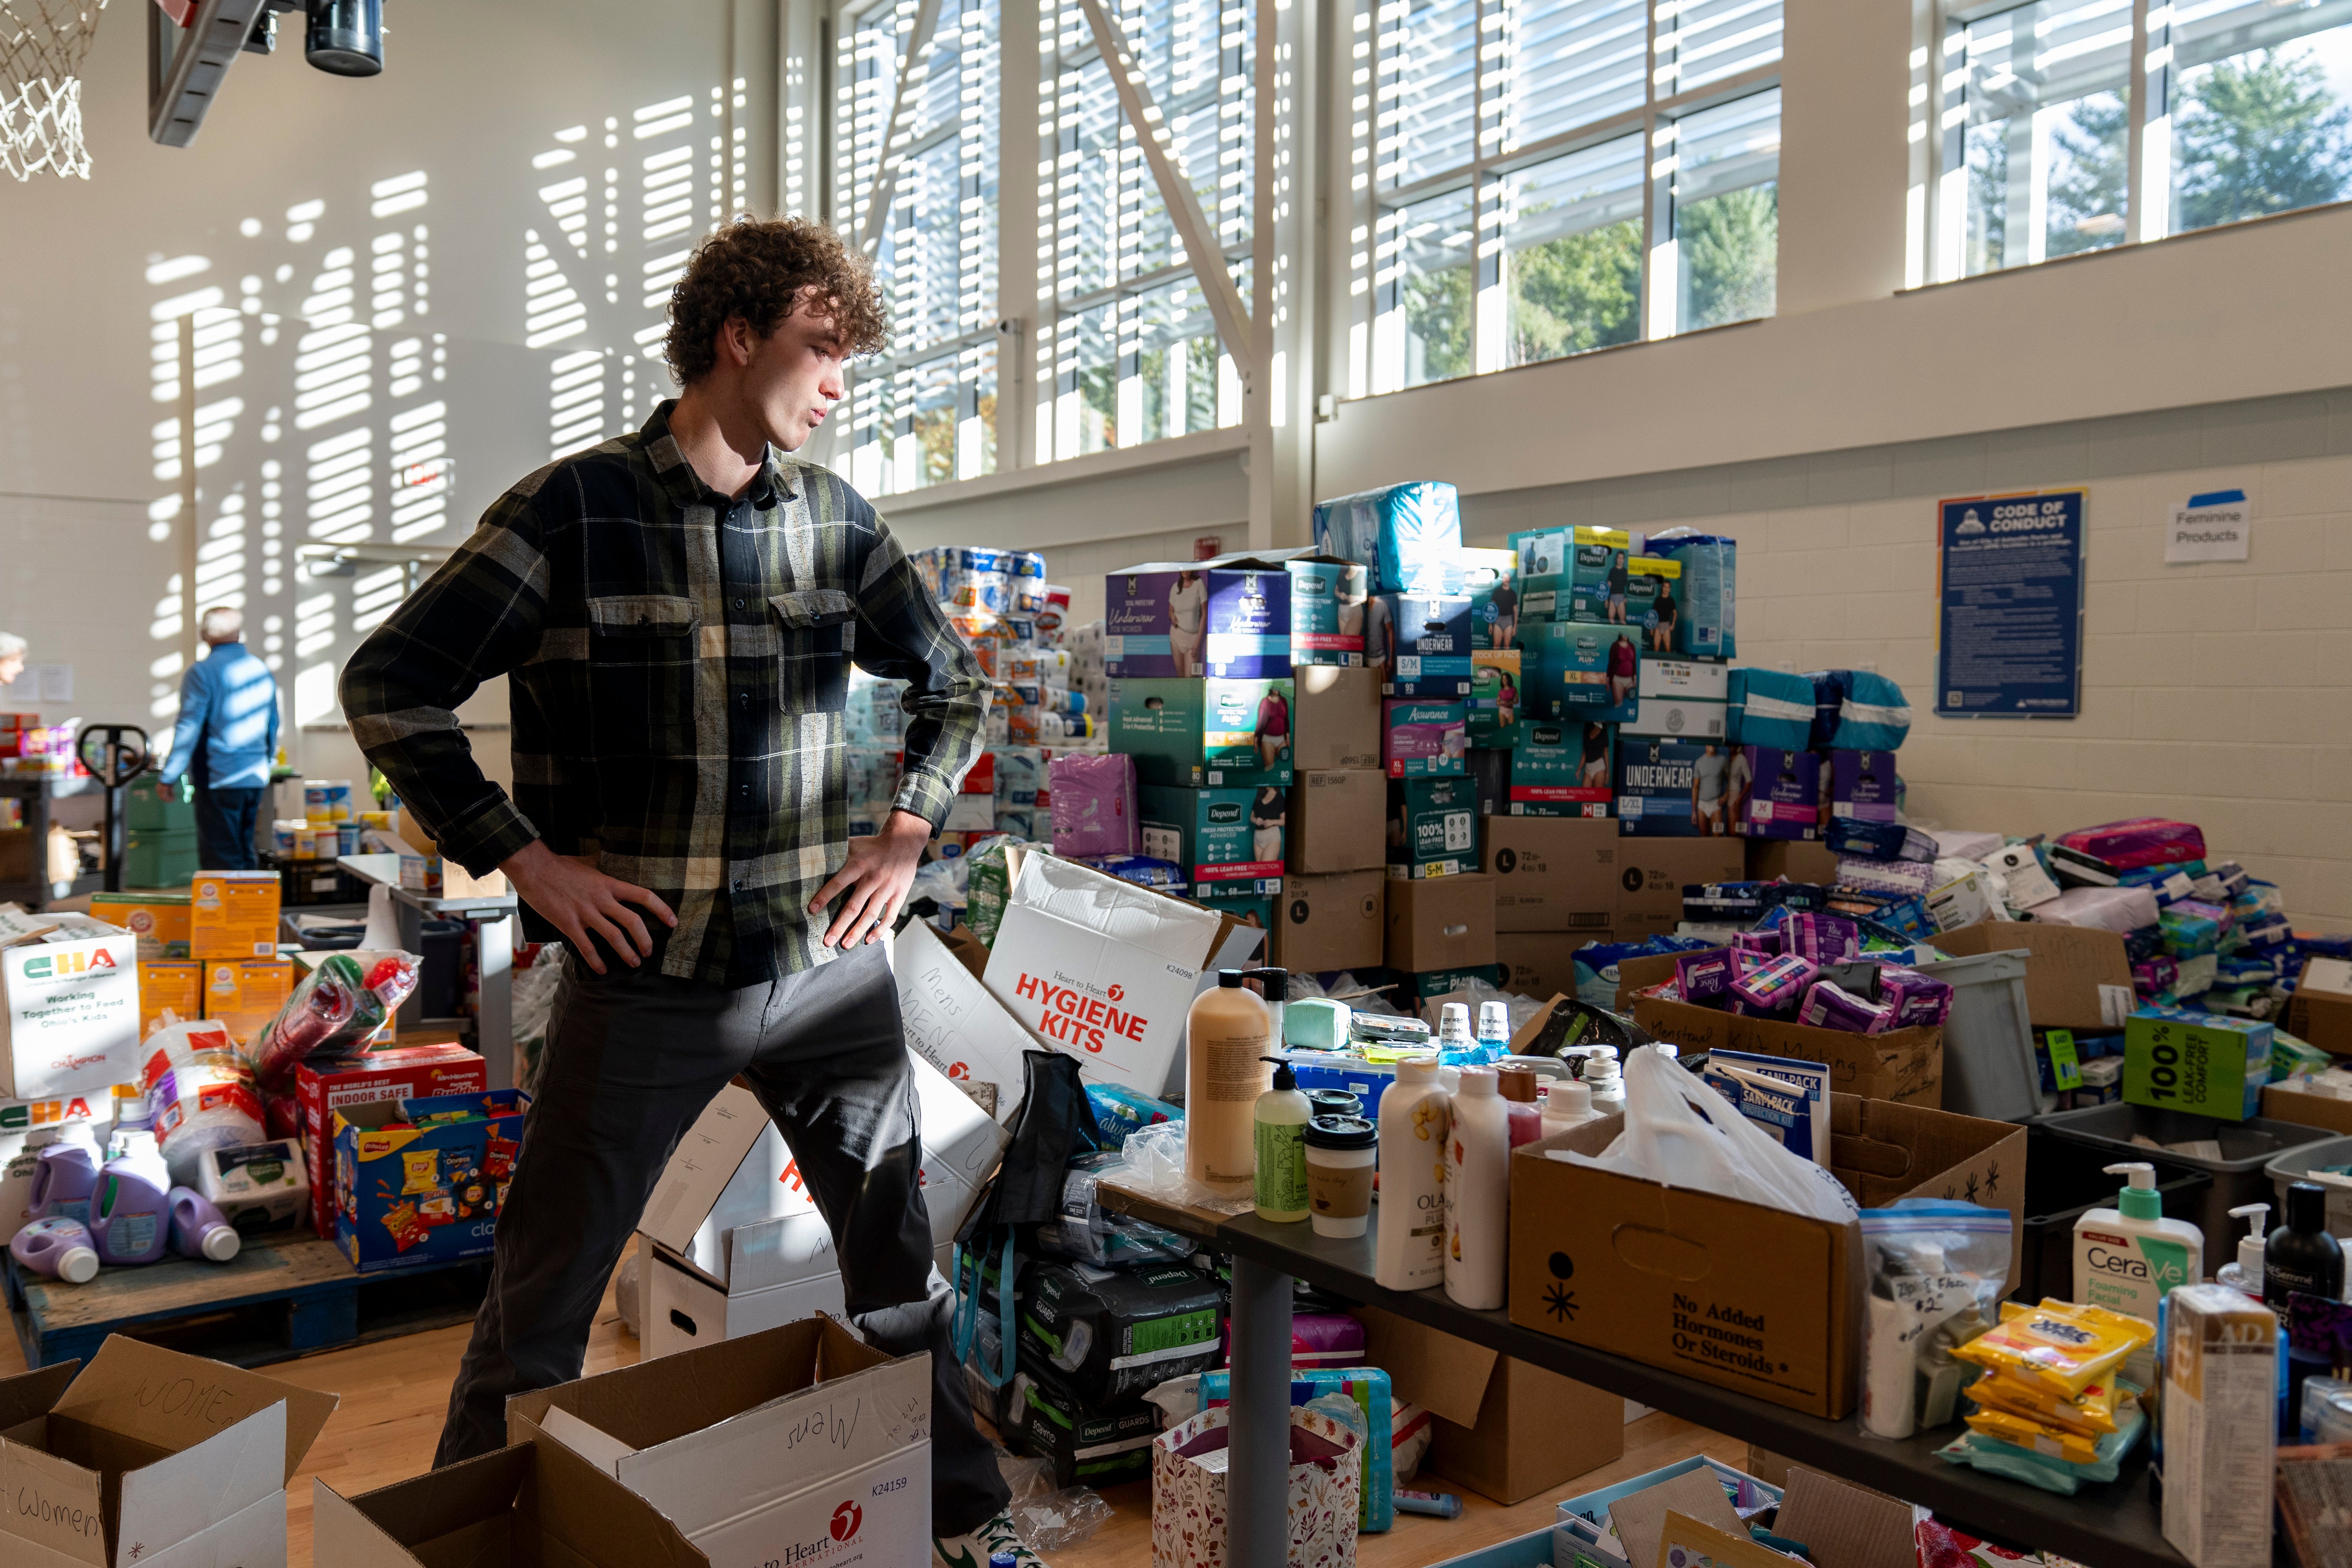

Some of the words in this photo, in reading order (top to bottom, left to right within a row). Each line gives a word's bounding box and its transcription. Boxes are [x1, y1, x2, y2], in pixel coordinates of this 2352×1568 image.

[1993, 502, 2038, 520] CODE
[2042, 500, 2064, 515] OF
[2176, 510, 2242, 525] Feminine
[1989, 513, 2068, 532] CONDUCT
[2176, 530, 2238, 543] Products
[1580, 552, 1603, 562] Depend
[1298, 579, 1324, 591] Depend
[1629, 583, 1653, 592] Depend
[1109, 608, 1156, 625] Underwear
[1417, 638, 1453, 651] UNDERWEAR
[1578, 639, 1596, 648] Depend
[1341, 654, 1347, 666] L
[1401, 659, 1417, 669] S/M
[1405, 683, 1414, 691] 92
[1408, 706, 1449, 722] Assurance
[1535, 731, 1559, 741] Depend
[1362, 755, 1375, 765] REF
[1192, 772, 1200, 780] 80
[1281, 770, 1289, 778] 80
[1311, 776, 1324, 785] REF
[1626, 765, 1692, 788] UNDERWEAR
[1211, 809, 1239, 819] Depend
[1584, 804, 1592, 816] M
[1417, 823, 1443, 838] 100%
[1419, 842, 1444, 850] PROTECTION
[1502, 855, 1509, 867] L
[1521, 852, 1530, 860] 72
[1427, 863, 1443, 875] S-M
[1521, 863, 1526, 872] 4
[1538, 864, 1546, 872] 18
[1649, 870, 1658, 879] 72
[1629, 872, 1636, 884] L
[1648, 881, 1654, 890] 4
[1665, 882, 1674, 890] 18
[1228, 887, 1237, 895] 68
[1256, 881, 1264, 893] L
[1296, 906, 1303, 917] L
[1366, 900, 1372, 911] B
[1826, 921, 1843, 936] Poise
[23, 948, 117, 979] CHA
[1515, 966, 1525, 975] 72
[1166, 964, 1193, 979] K24098
[920, 967, 962, 1015] Mens
[1054, 970, 1076, 986] Heart
[1076, 980, 1084, 989] to
[1085, 982, 1107, 997] Heart
[1699, 977, 1722, 993] Poise
[45, 991, 95, 1004] Working
[1079, 989, 1122, 1008] INTERNATIONAL
[21, 1005, 76, 1019] Together
[96, 999, 123, 1008] Feed
[1015, 972, 1148, 1042] HYGIENE
[41, 1017, 77, 1028] Ohio's
[82, 1014, 108, 1022] Kids
[899, 988, 955, 1045] MEN
[1038, 1009, 1105, 1053] KITS
[1727, 1030, 1769, 1052] Kit
[51, 1054, 106, 1070] CHAMPION
[915, 1037, 924, 1049] to
[924, 1045, 948, 1073] Heart
[2150, 1026, 2179, 1100] 100%
[2183, 1033, 2198, 1104] LEAK-FREE
[2196, 1038, 2210, 1103] COMFORT
[343, 1081, 372, 1090] WORLD'S
[373, 1079, 390, 1087] BEST
[1760, 1070, 1818, 1090] SANI-PACK
[332, 1091, 375, 1105] INDOOR
[380, 1087, 408, 1100] SAFE
[1743, 1089, 1795, 1111] SANI-PACK
[0, 1097, 92, 1128] CHA
[1744, 1105, 1779, 1122] PROTECTION
[1781, 1116, 1792, 1125] KIT
[446, 1156, 470, 1165] Doritos
[489, 1151, 510, 1159] Doritos
[1332, 1176, 1347, 1187] day
[1417, 1192, 1445, 1210] OLA
[2088, 1247, 2182, 1283] CeraVe
[1148, 1270, 1189, 1285] Depend
[1043, 1278, 1061, 1300] Depend
[2088, 1278, 2138, 1299] Foaming
[2088, 1289, 2121, 1305] Facial
[1036, 1300, 1055, 1324] GUARDS
[1673, 1292, 1698, 1313] No
[1706, 1303, 1764, 1332] Added
[1021, 1330, 1030, 1341] 52
[1673, 1312, 1764, 1352] Hormones
[1672, 1332, 1697, 1352] Or
[1701, 1340, 1773, 1374] Steroids
[1062, 1401, 1069, 1411] 52
[787, 1397, 860, 1449] Mens
[1085, 1423, 1112, 1437] Depend
[1119, 1416, 1150, 1429] GUARDS
[1032, 1420, 1056, 1443] GUARDS
[872, 1477, 907, 1497] K24159
[18, 1486, 99, 1537] Women
[784, 1535, 829, 1566] Heart
